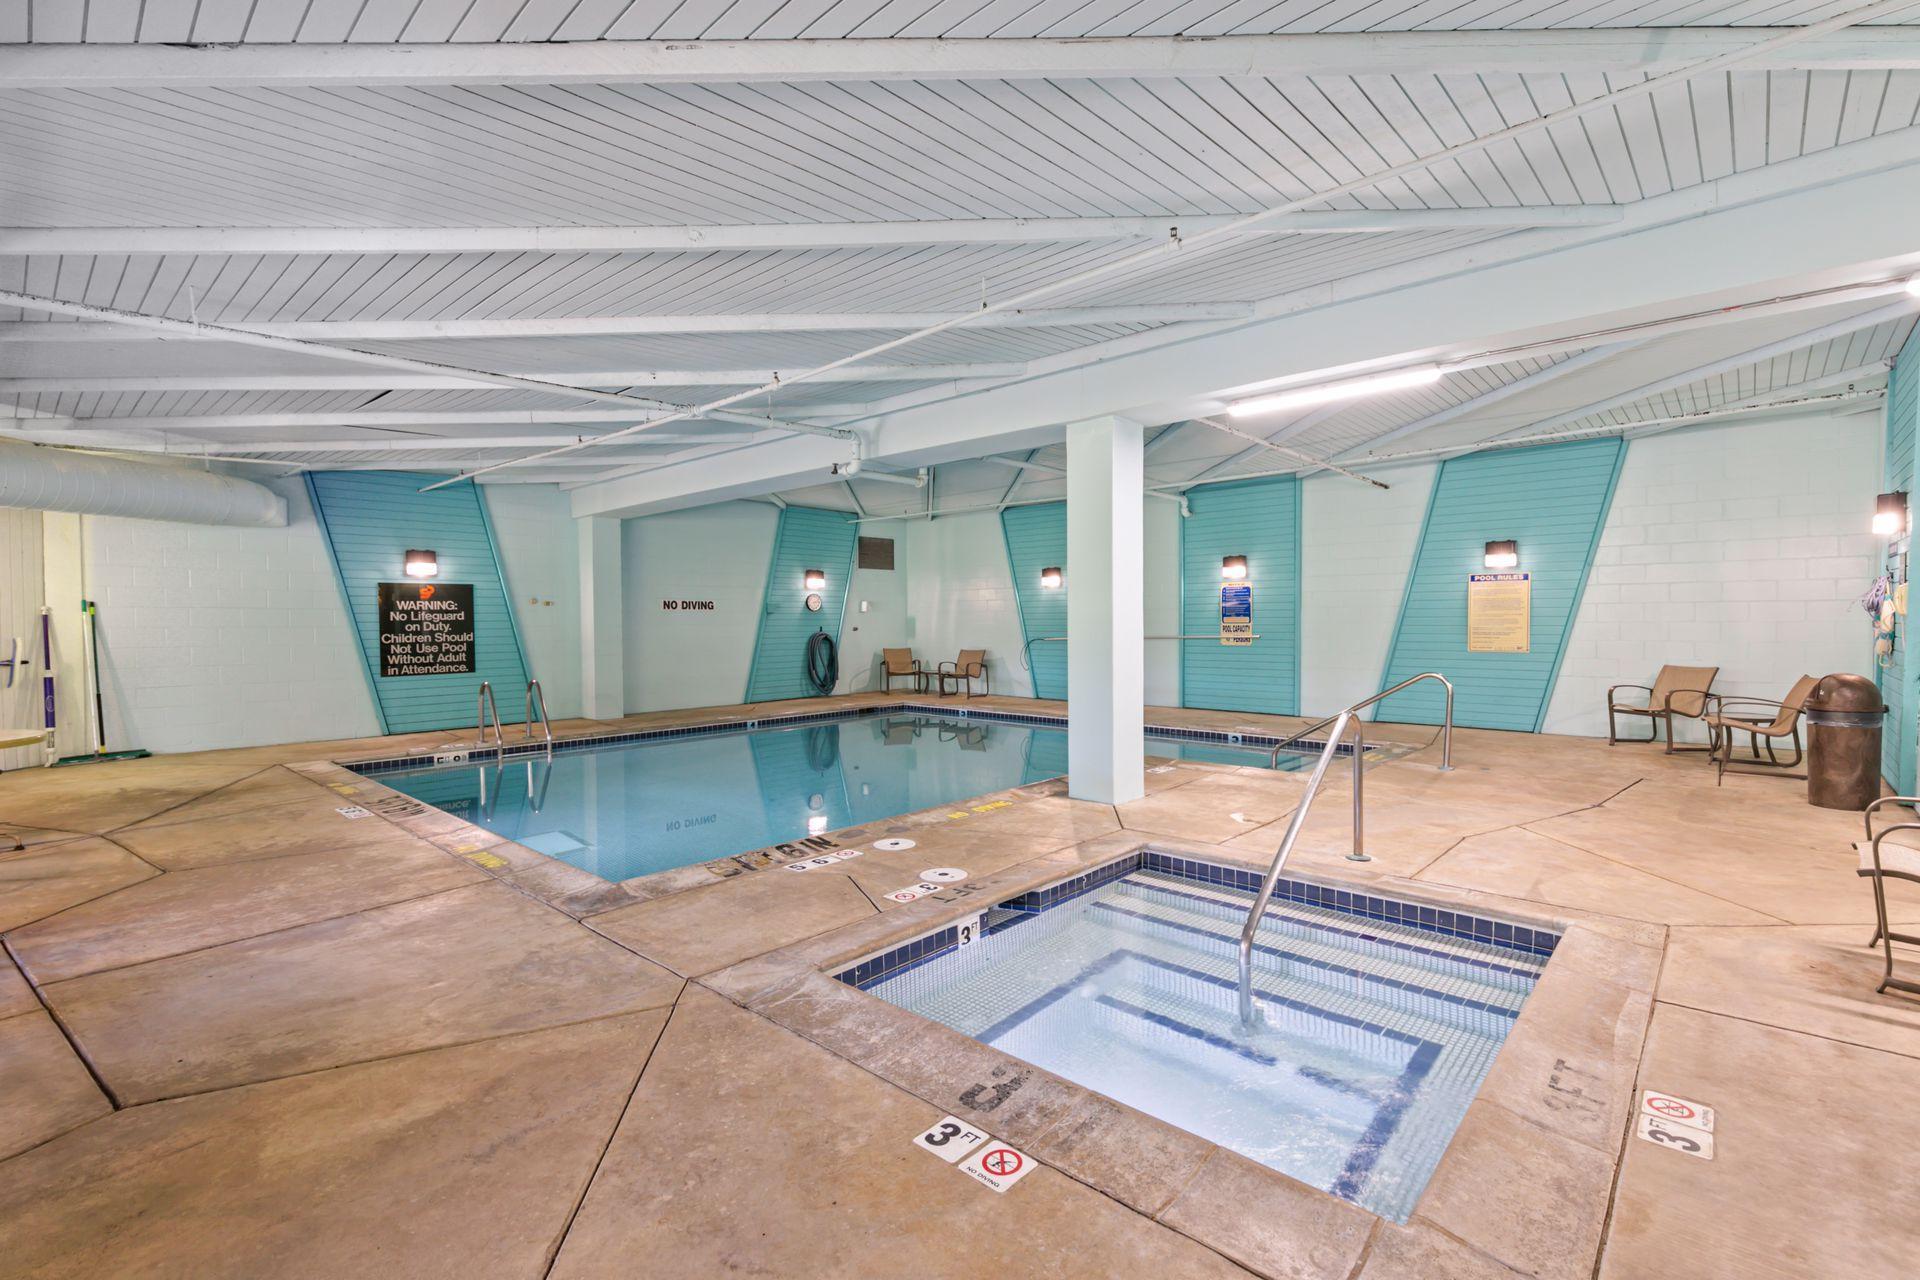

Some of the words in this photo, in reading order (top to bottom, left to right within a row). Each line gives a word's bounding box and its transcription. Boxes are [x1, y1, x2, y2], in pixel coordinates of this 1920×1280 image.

[396, 600, 458, 611] WARNING:
[663, 600, 678, 610] NO
[681, 600, 714, 610] DIVING
[389, 611, 407, 621] No
[410, 611, 465, 622] Lifeguard
[405, 624, 420, 632] on
[423, 622, 452, 632] Duty.
[381, 633, 432, 644] Children
[434, 632, 474, 642] Should
[390, 644, 412, 654] Not
[416, 643, 438, 653] Use
[442, 643, 467, 652] Pool
[387, 654, 434, 664] Without
[437, 652, 467, 662] Adult
[387, 666, 399, 675] in
[401, 664, 469, 675] Attendance.
[961, 926, 971, 945] 3
[971, 921, 978, 931] FT
[924, 1123, 961, 1147] 3
[960, 1131, 981, 1144] FT
[1647, 1130, 1702, 1152] 3
[966, 1166, 977, 1175] NO
[976, 1172, 1000, 1188] DIVING
